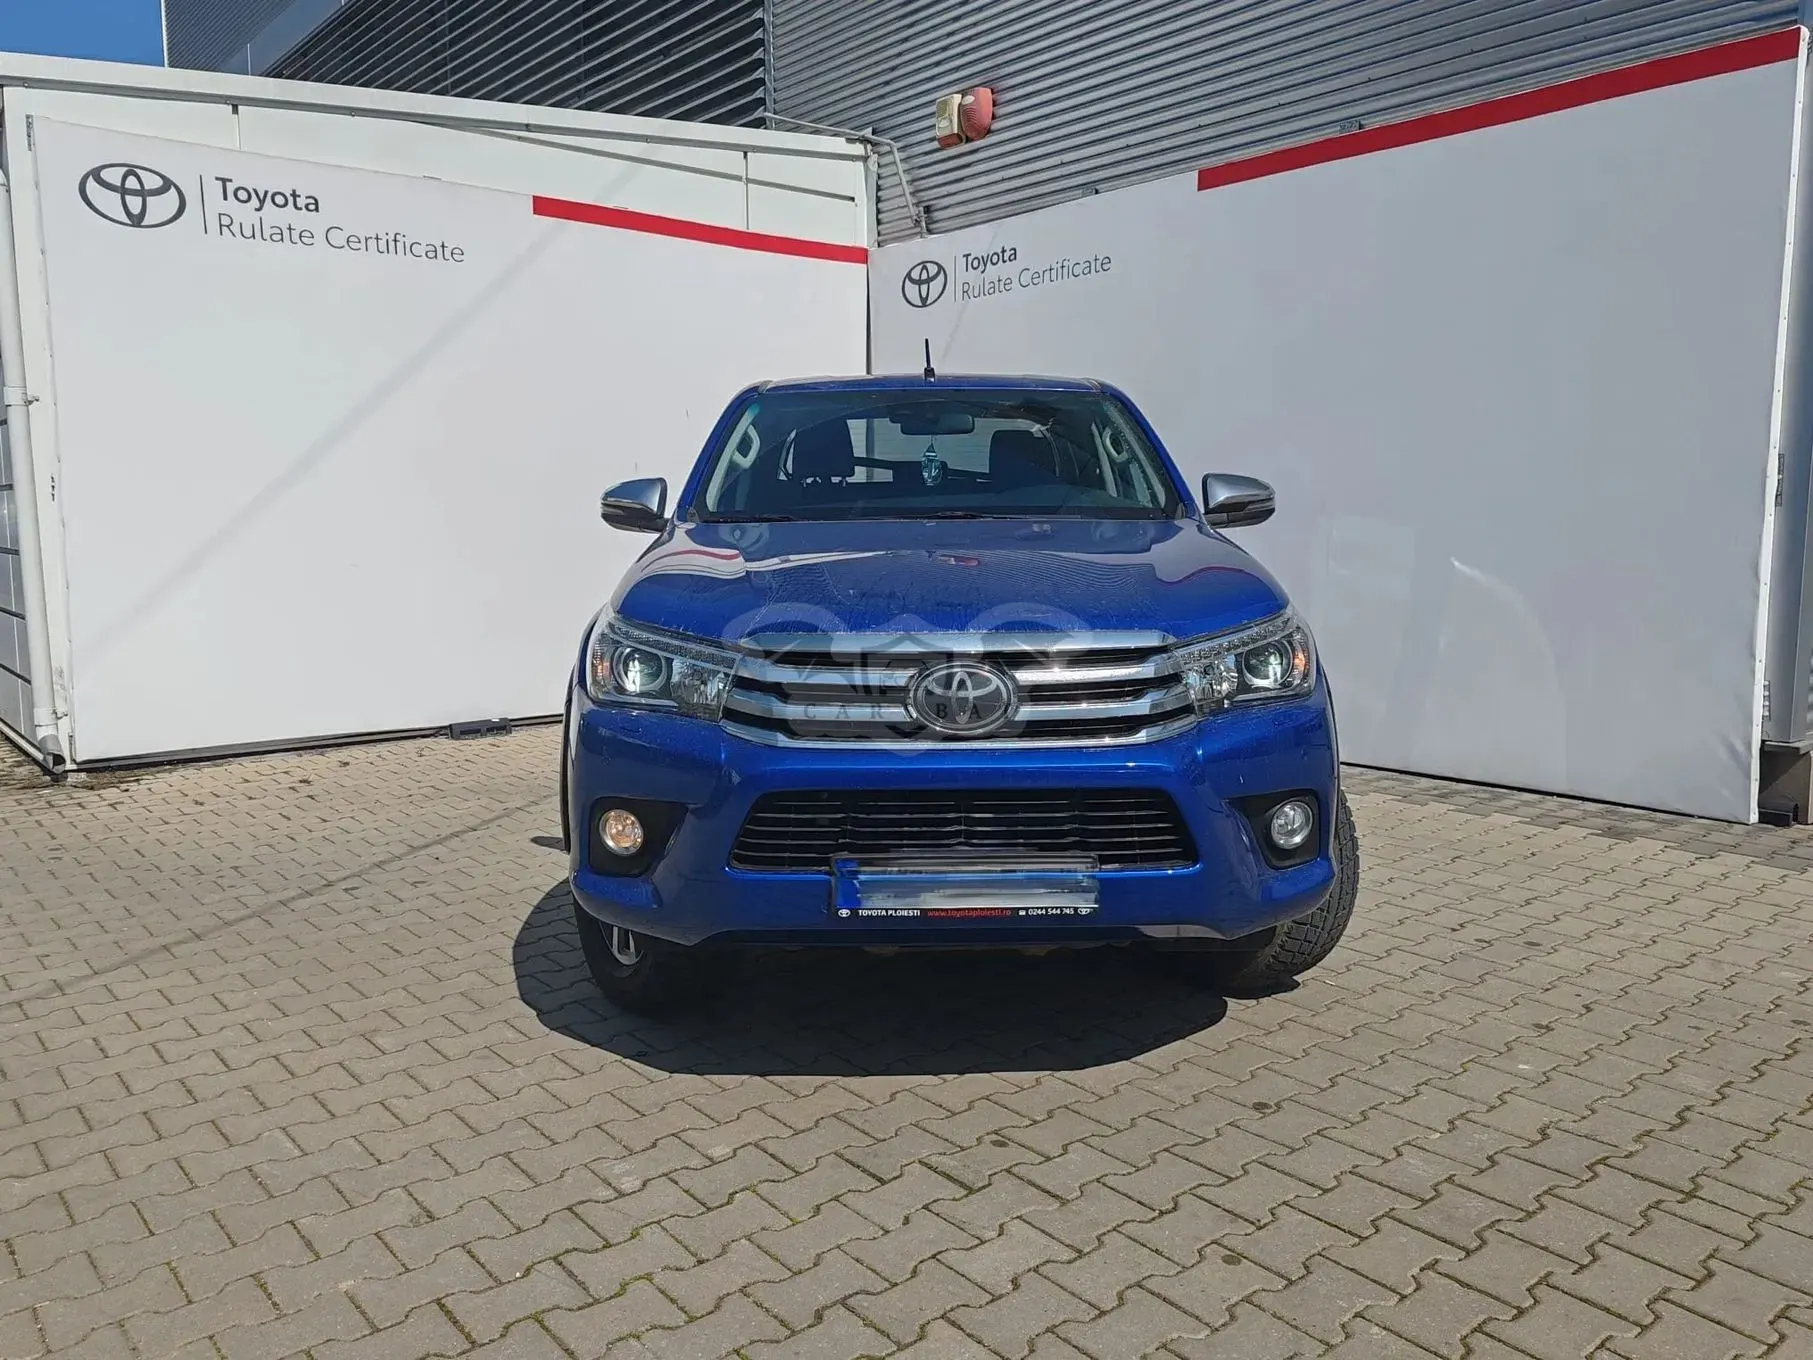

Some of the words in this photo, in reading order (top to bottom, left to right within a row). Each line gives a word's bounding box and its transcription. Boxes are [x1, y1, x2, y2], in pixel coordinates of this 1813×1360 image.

[215, 176, 320, 213] Toyota
[217, 213, 315, 247] Rulate
[325, 226, 465, 263] Certificate
[961, 277, 1013, 301] Rulate
[1018, 254, 1112, 289] Certificate
[962, 246, 1018, 274] Toyota
[888, 909, 920, 917] PLOIESTI
[928, 909, 1011, 917] www.toyotaploiesti.ro
